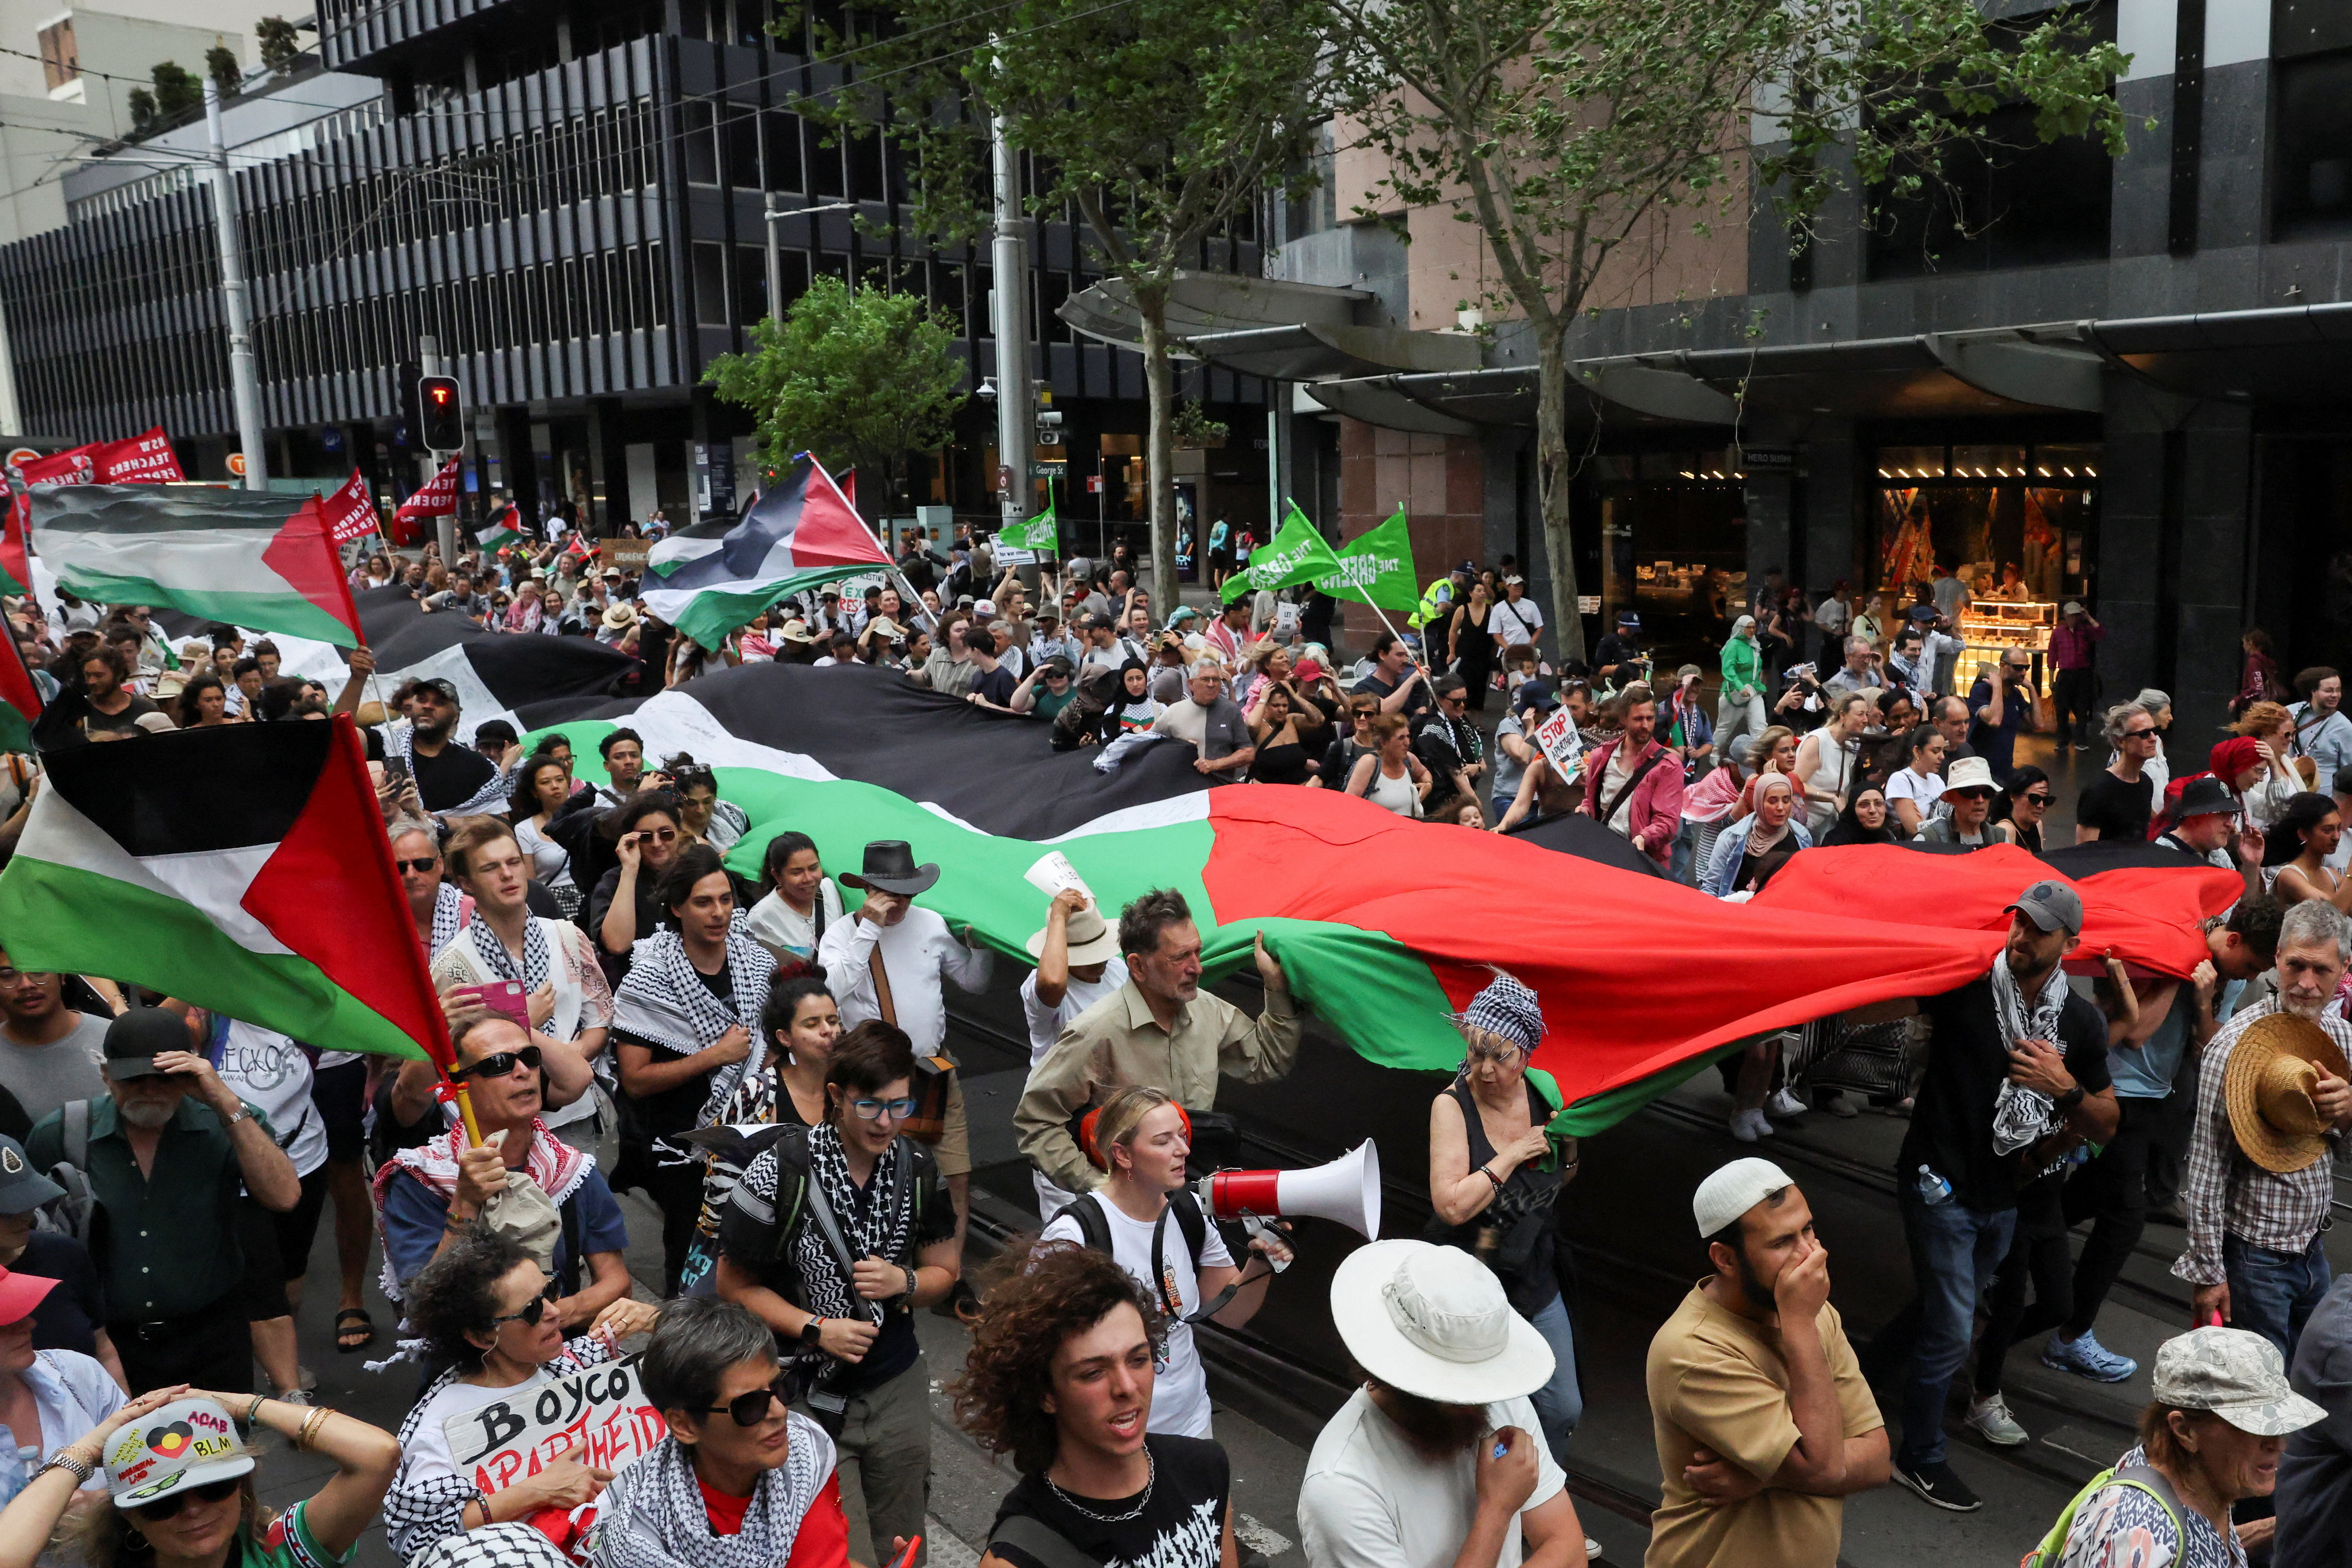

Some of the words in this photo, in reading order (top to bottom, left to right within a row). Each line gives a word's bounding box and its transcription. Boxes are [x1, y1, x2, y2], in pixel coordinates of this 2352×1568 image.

[434, 390, 446, 402] T
[1748, 453, 1768, 462] HERO
[1036, 465, 1056, 476] George
[1057, 466, 1063, 474] St
[1541, 713, 1566, 748] STOP
[1551, 731, 1576, 761] APARTHEID
[1051, 857, 1070, 869] Fre
[462, 1350, 646, 1465] BOYCOT
[188, 1411, 228, 1434] ACAB
[111, 1442, 128, 1466] ALWAYS
[128, 1428, 140, 1442] WAS
[121, 1437, 139, 1462] ALWAYS
[127, 1451, 139, 1464] WILL
[138, 1440, 145, 1449] BE
